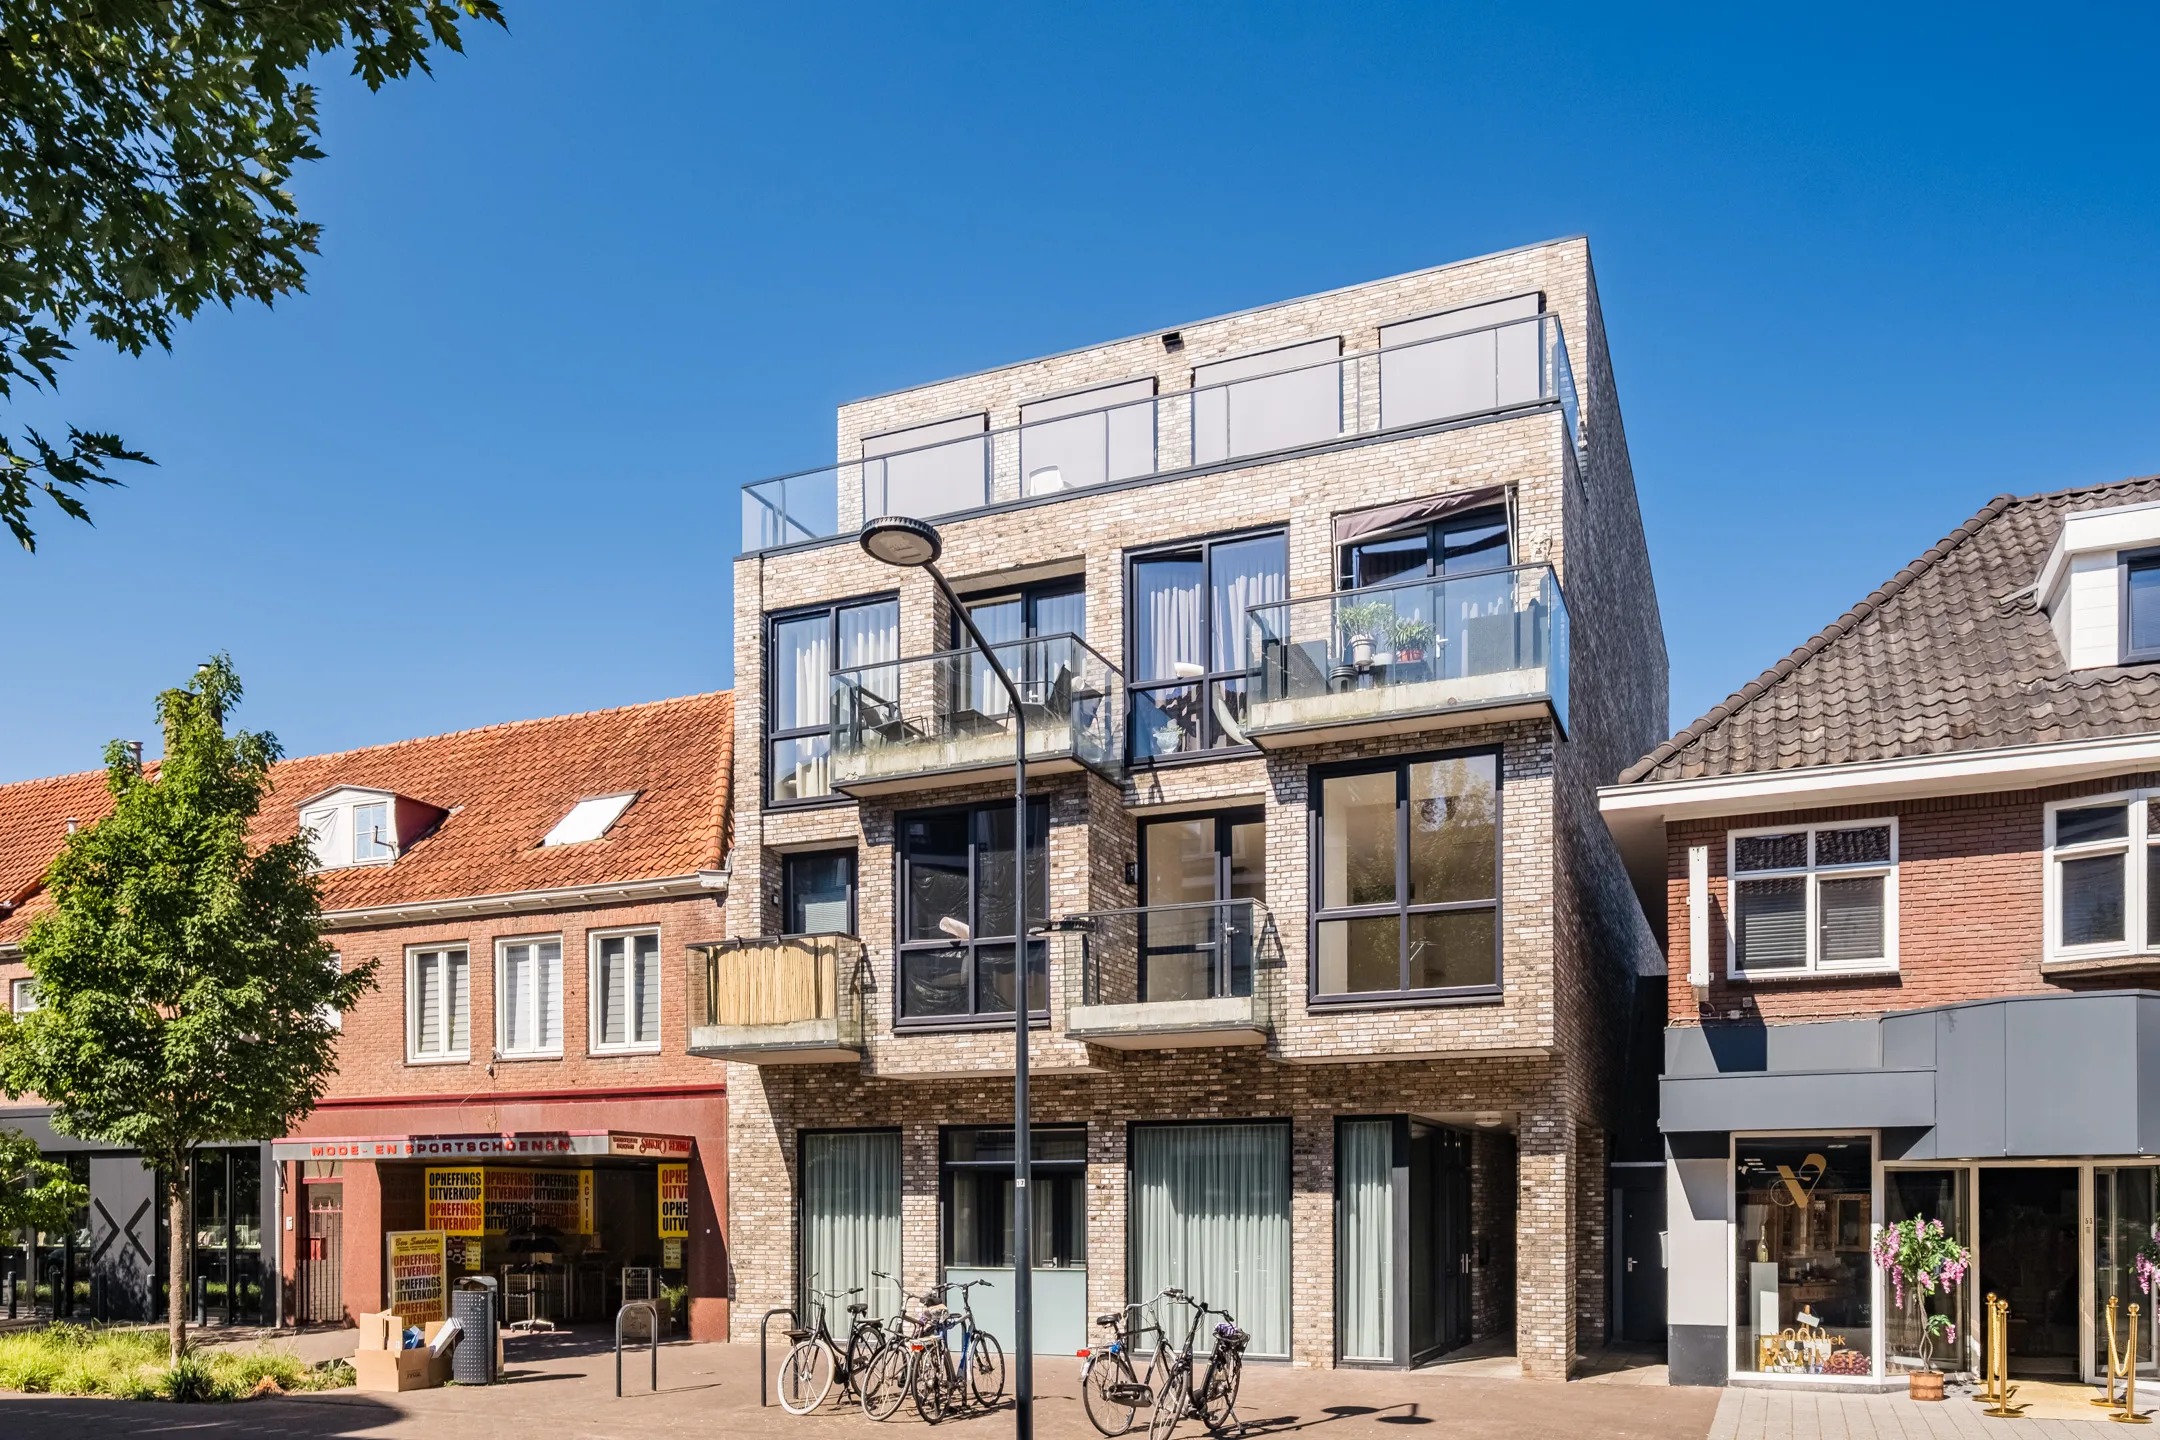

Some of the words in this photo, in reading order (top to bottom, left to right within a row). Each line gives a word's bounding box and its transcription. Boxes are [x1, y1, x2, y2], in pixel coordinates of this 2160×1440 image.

[375, 1144, 397, 1155] EN
[405, 1140, 570, 1156] SPORTSCHOENEN
[429, 1172, 481, 1186] OPHEFFINGS
[485, 1171, 534, 1186] OPHEFFINGS
[534, 1173, 579, 1187] OPHEFFINGS
[429, 1187, 481, 1200] UITVERKOOP
[485, 1186, 534, 1200] UITVERKOOP
[534, 1188, 579, 1201] UITVERKOOP
[429, 1202, 481, 1216] OPHEFFINGS
[429, 1217, 481, 1230] UITVERKOOP
[394, 1253, 441, 1266] OPHEFFINGS
[394, 1265, 442, 1278] UITVERKOOP
[395, 1276, 441, 1290] OPHEFFINGS
[395, 1288, 442, 1302] UITVERKOOP
[395, 1300, 442, 1314] OPHEFFINGS
[402, 1312, 443, 1326] TVERKOOP
